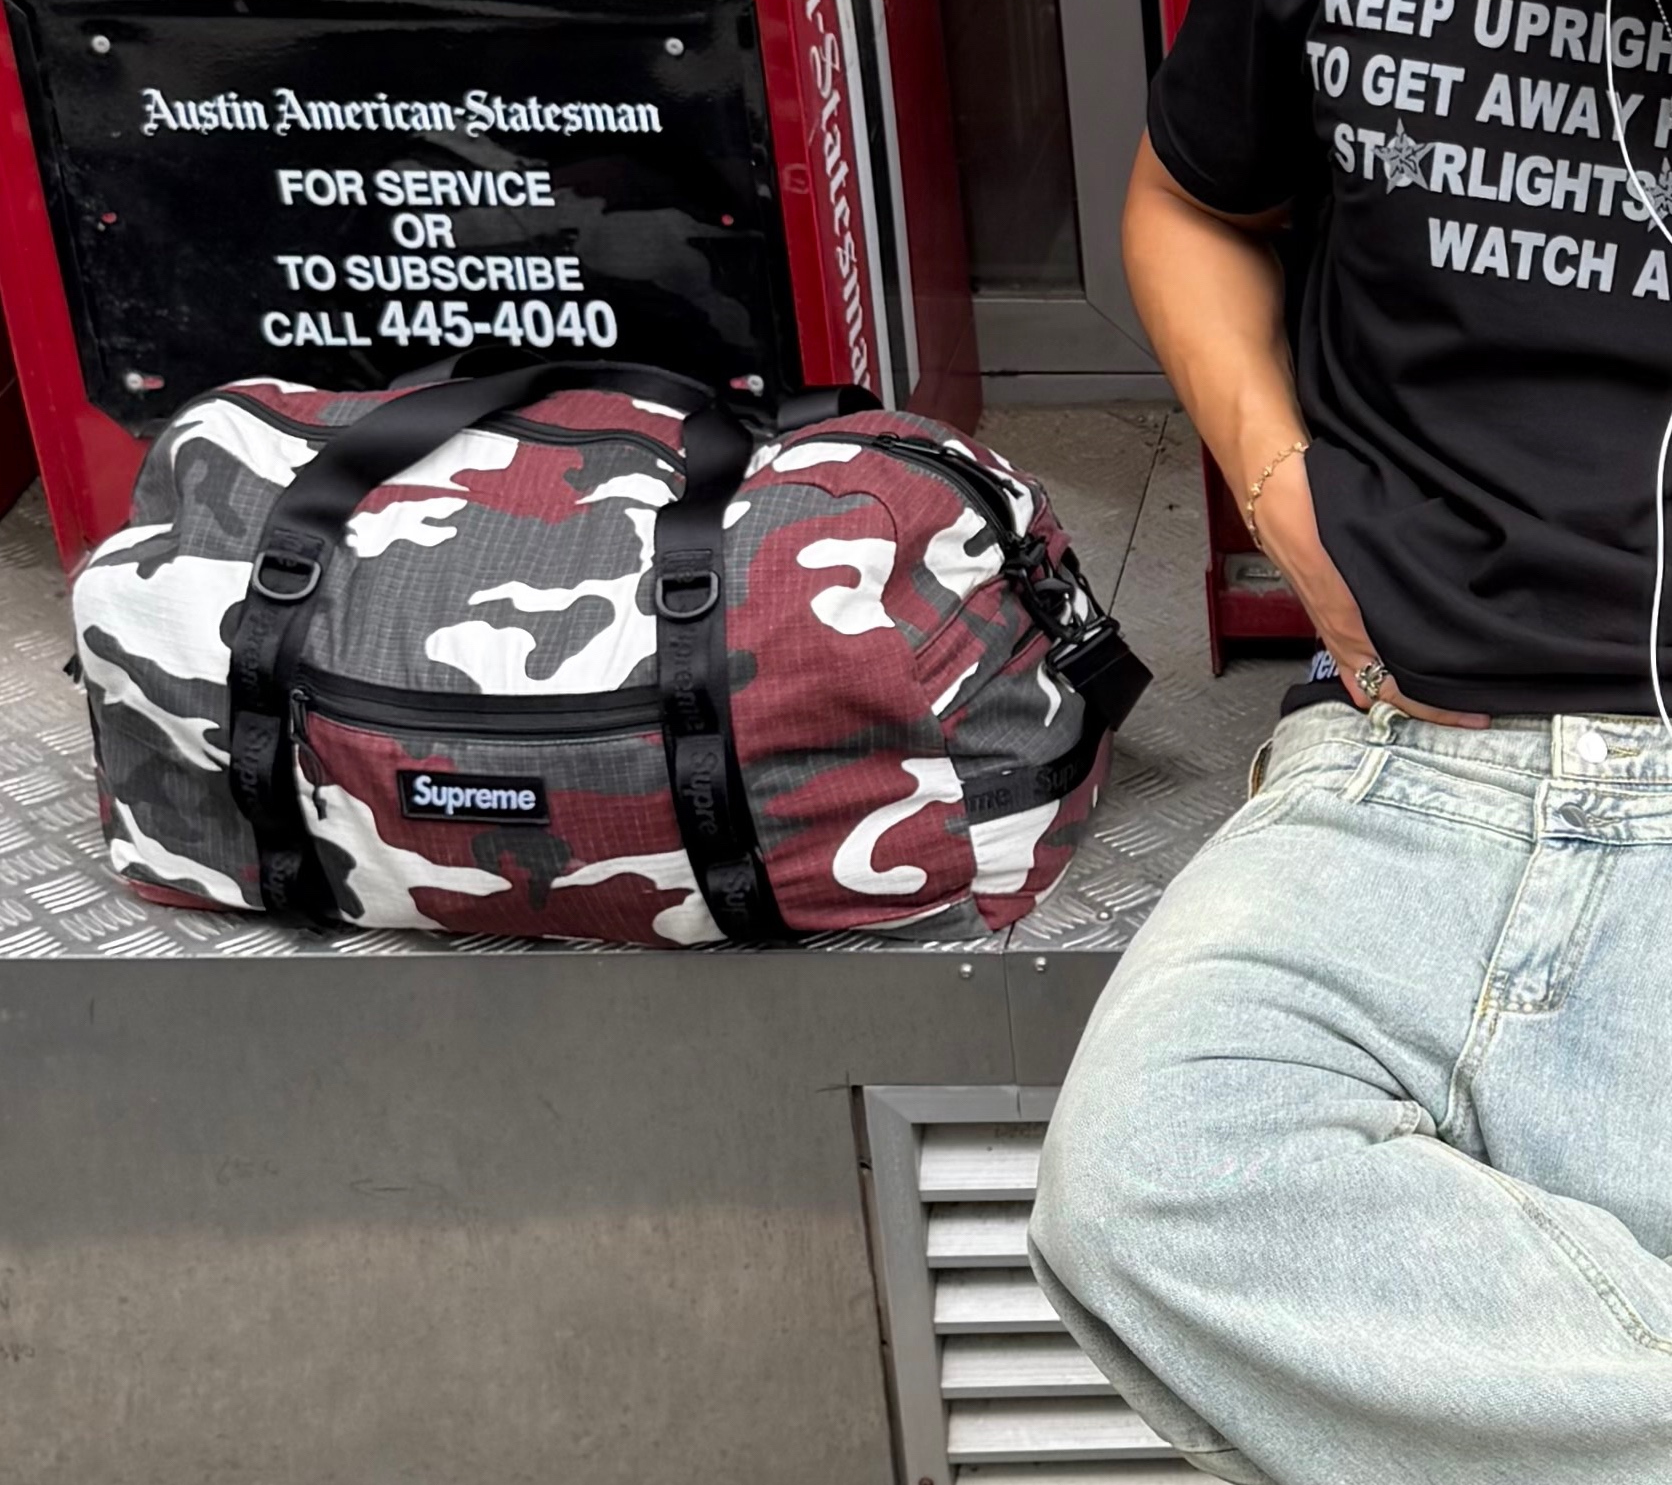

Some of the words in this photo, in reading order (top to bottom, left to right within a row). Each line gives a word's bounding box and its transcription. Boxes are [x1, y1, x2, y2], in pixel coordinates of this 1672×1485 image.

[140, 88, 269, 136] Austin
[273, 88, 662, 136] American-Statesman
[1306, 41, 1350, 98] TO
[1362, 54, 1465, 116] GET
[1475, 73, 1644, 142] AWAY
[276, 169, 367, 206] FOR
[375, 169, 555, 207] SERVICE
[392, 213, 455, 249] OR
[276, 255, 336, 291] TO
[345, 255, 584, 291] SUBSCRIBE
[1428, 217, 1618, 292] WATCH
[262, 312, 372, 347] CALL
[379, 299, 618, 349] 445-4040
[413, 775, 536, 815] Supreme
